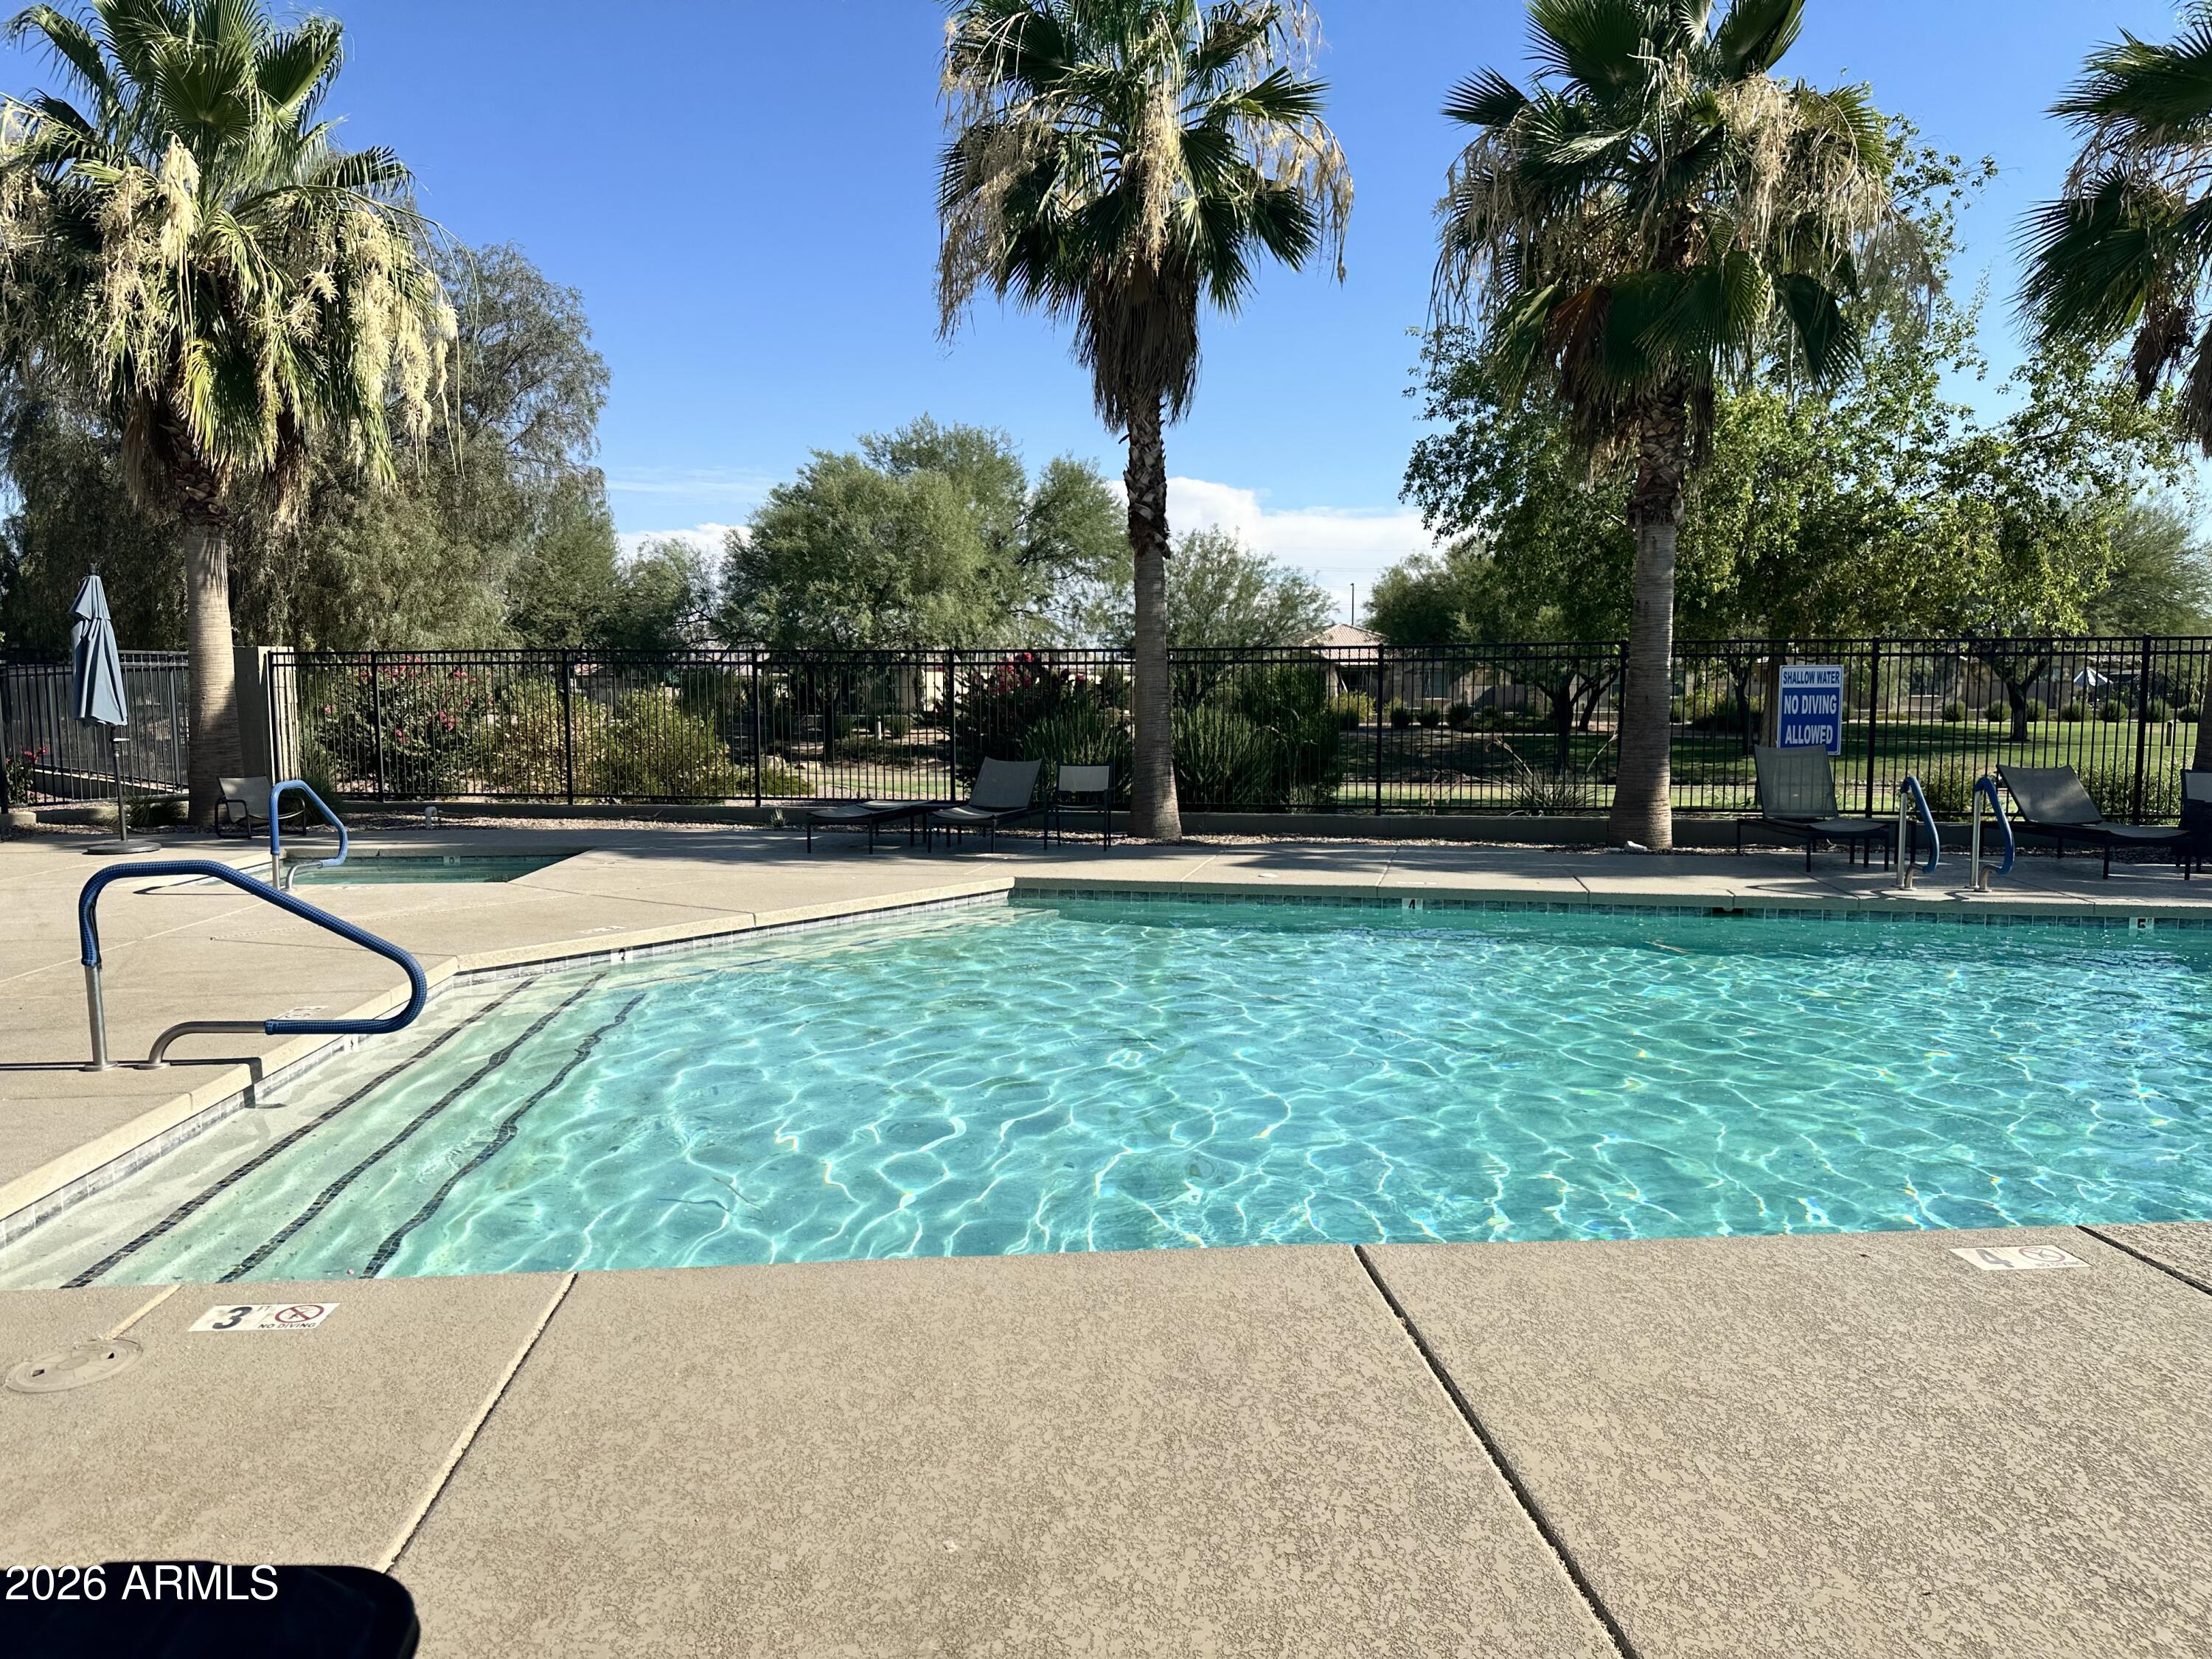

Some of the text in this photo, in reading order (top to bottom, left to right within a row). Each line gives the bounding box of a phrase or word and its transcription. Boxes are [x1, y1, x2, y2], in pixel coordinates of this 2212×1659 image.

[1783, 671, 1840, 684] SHALLOW WATER
[1784, 695, 1837, 714] NO DIVING
[1785, 725, 1833, 745] ALLOWED
[1975, 1248, 2015, 1268] 4
[212, 1306, 253, 1329] 3
